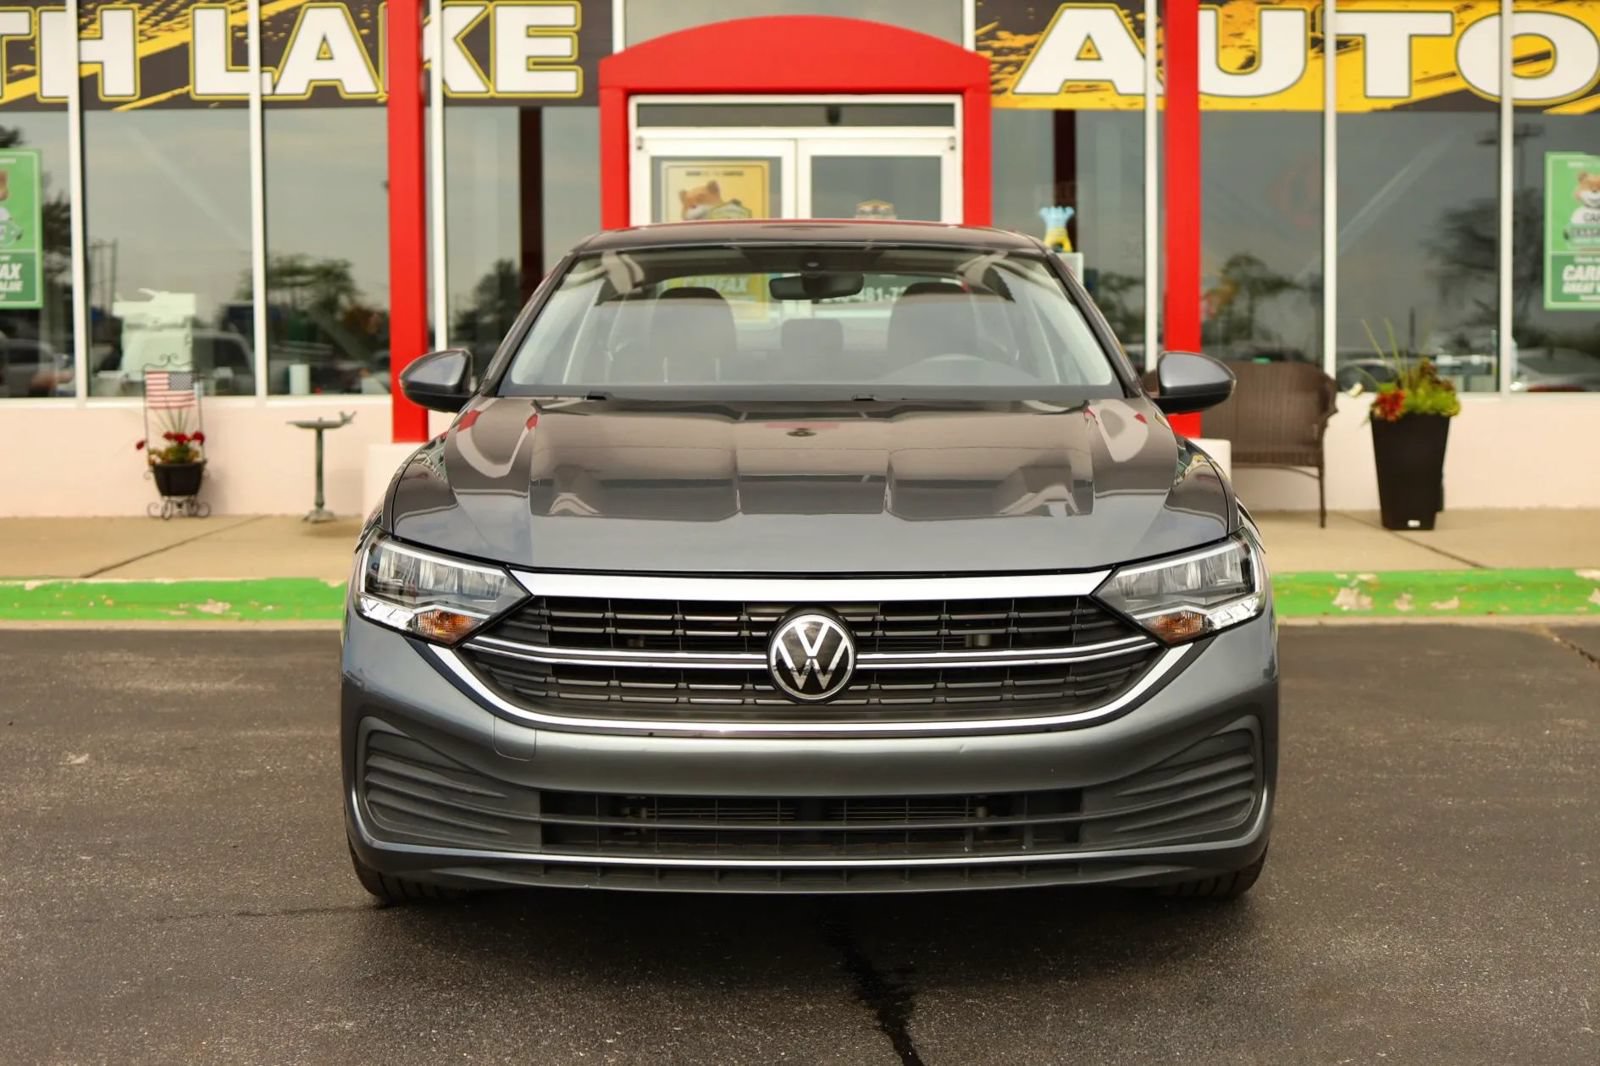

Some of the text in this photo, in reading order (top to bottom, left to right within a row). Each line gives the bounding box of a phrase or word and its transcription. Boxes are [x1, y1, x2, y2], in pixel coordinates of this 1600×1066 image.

[189, 2, 583, 100] LAKE
[1010, 3, 1600, 104] AUTO
[773, 618, 851, 695] VW
